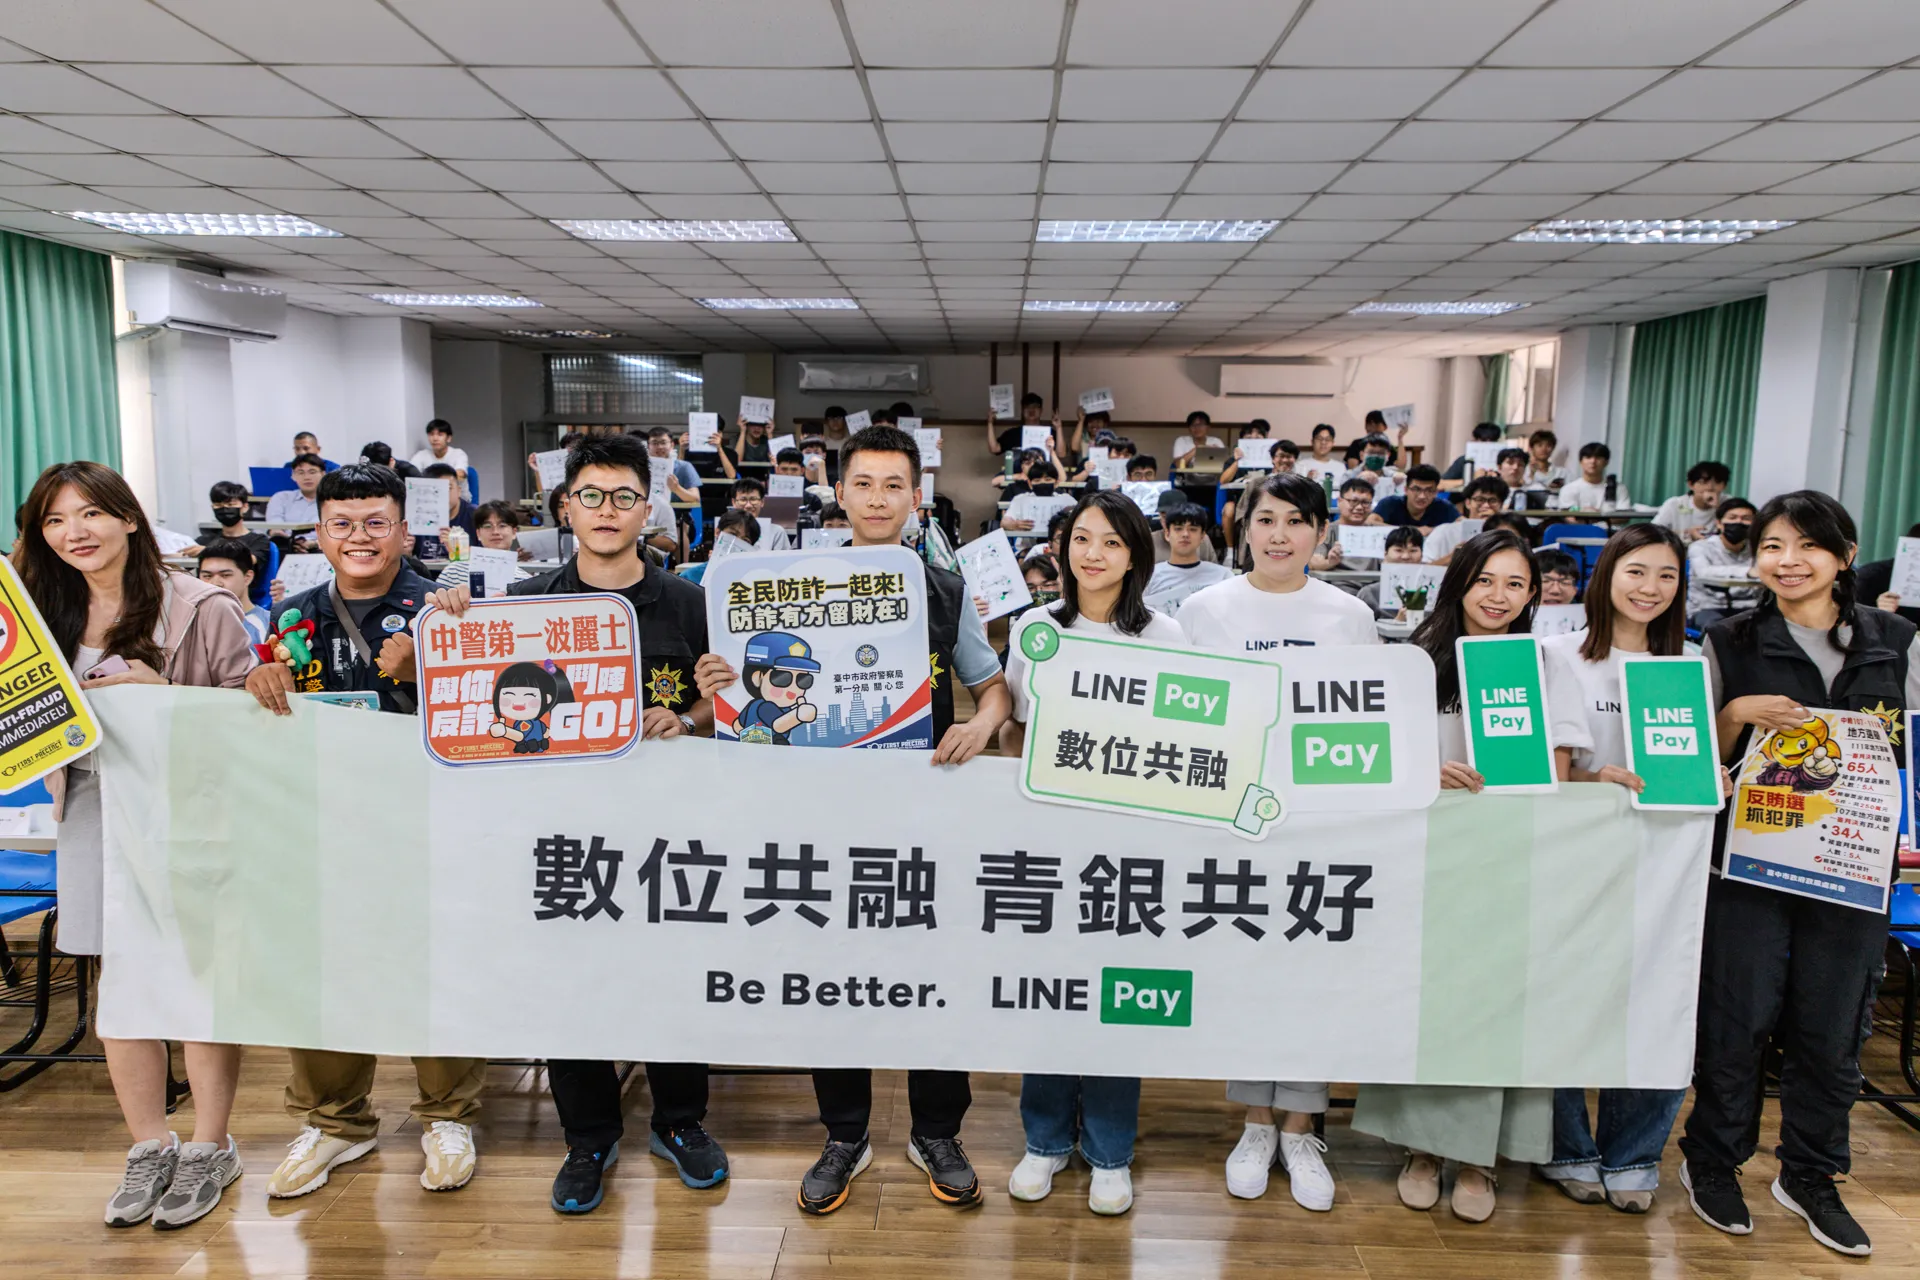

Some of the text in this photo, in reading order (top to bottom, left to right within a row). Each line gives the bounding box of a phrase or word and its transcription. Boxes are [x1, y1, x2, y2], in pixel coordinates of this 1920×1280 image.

[727, 572, 905, 605] 全民防詐一起來!
[729, 597, 908, 633] 防詐有方留財在!
[430, 613, 627, 662] 中警第一波麗士
[834, 670, 904, 682] 臺中市政府警察局
[834, 682, 869, 694] 第一分局
[1071, 670, 1220, 717] LINE Pay
[1292, 679, 1386, 714] LINE
[1481, 687, 1528, 705] LINE
[430, 702, 495, 738] 反詐
[549, 698, 635, 742] GO!
[1489, 714, 1525, 731] Pay
[1643, 707, 1694, 724] LINE
[1304, 736, 1379, 774] Pay
[1652, 732, 1690, 751] Pay
[1053, 729, 1229, 791] 數位共融
[1847, 762, 1878, 774] 65人
[1746, 789, 1806, 811] 反賄選
[1745, 806, 1804, 828] 抓犯罪
[1834, 807, 1890, 823] 107年地方選舉
[1831, 825, 1864, 841] 34人
[534, 834, 1374, 943] 數位共融 青銀共好
[706, 971, 1182, 1017] Be Better. LINE Pay
